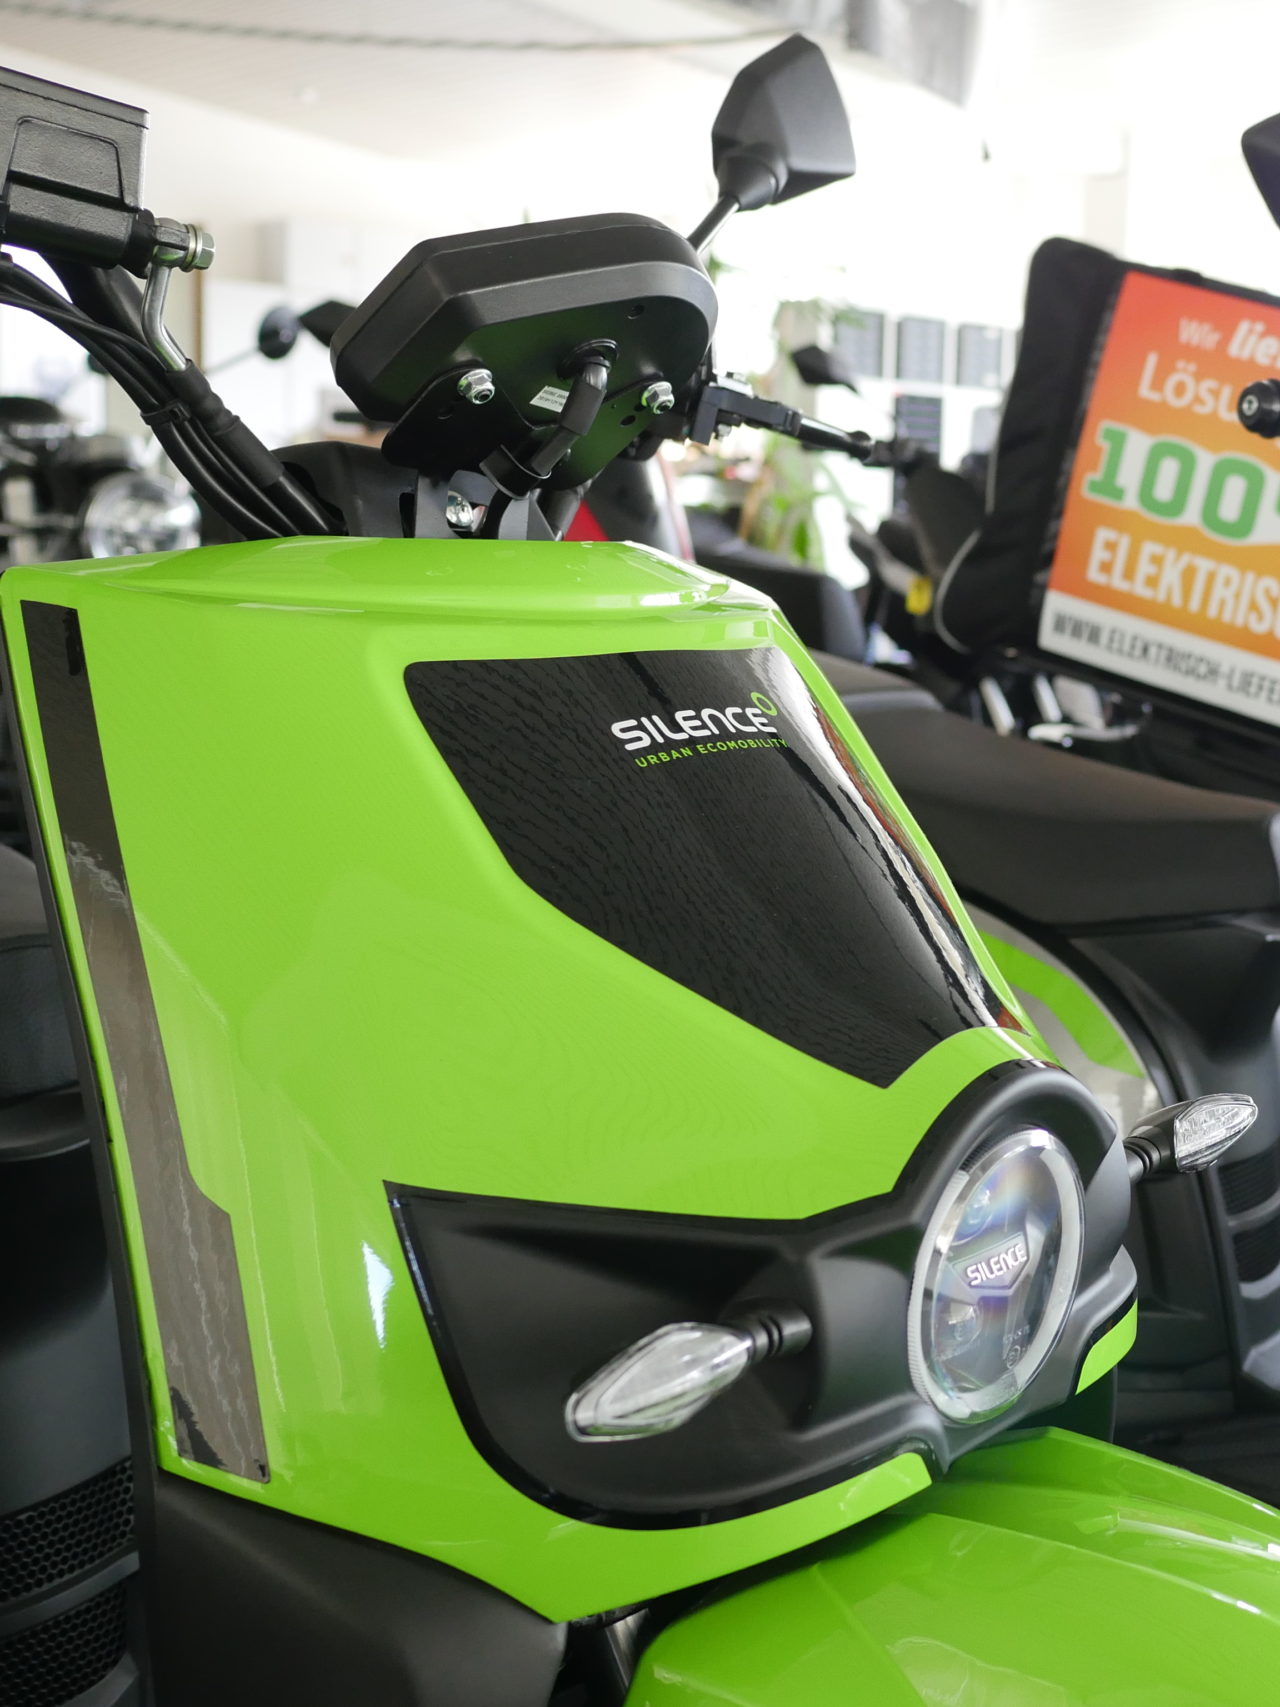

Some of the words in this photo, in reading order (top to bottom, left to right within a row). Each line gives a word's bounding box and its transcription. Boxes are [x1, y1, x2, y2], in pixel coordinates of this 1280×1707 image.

[1178, 317, 1222, 349] Wir
[611, 706, 777, 750] SILENCE
[635, 747, 694, 768] URBAN
[696, 739, 788, 754] ECOMOBILITY
[967, 1243, 1027, 1286] SILENCE
